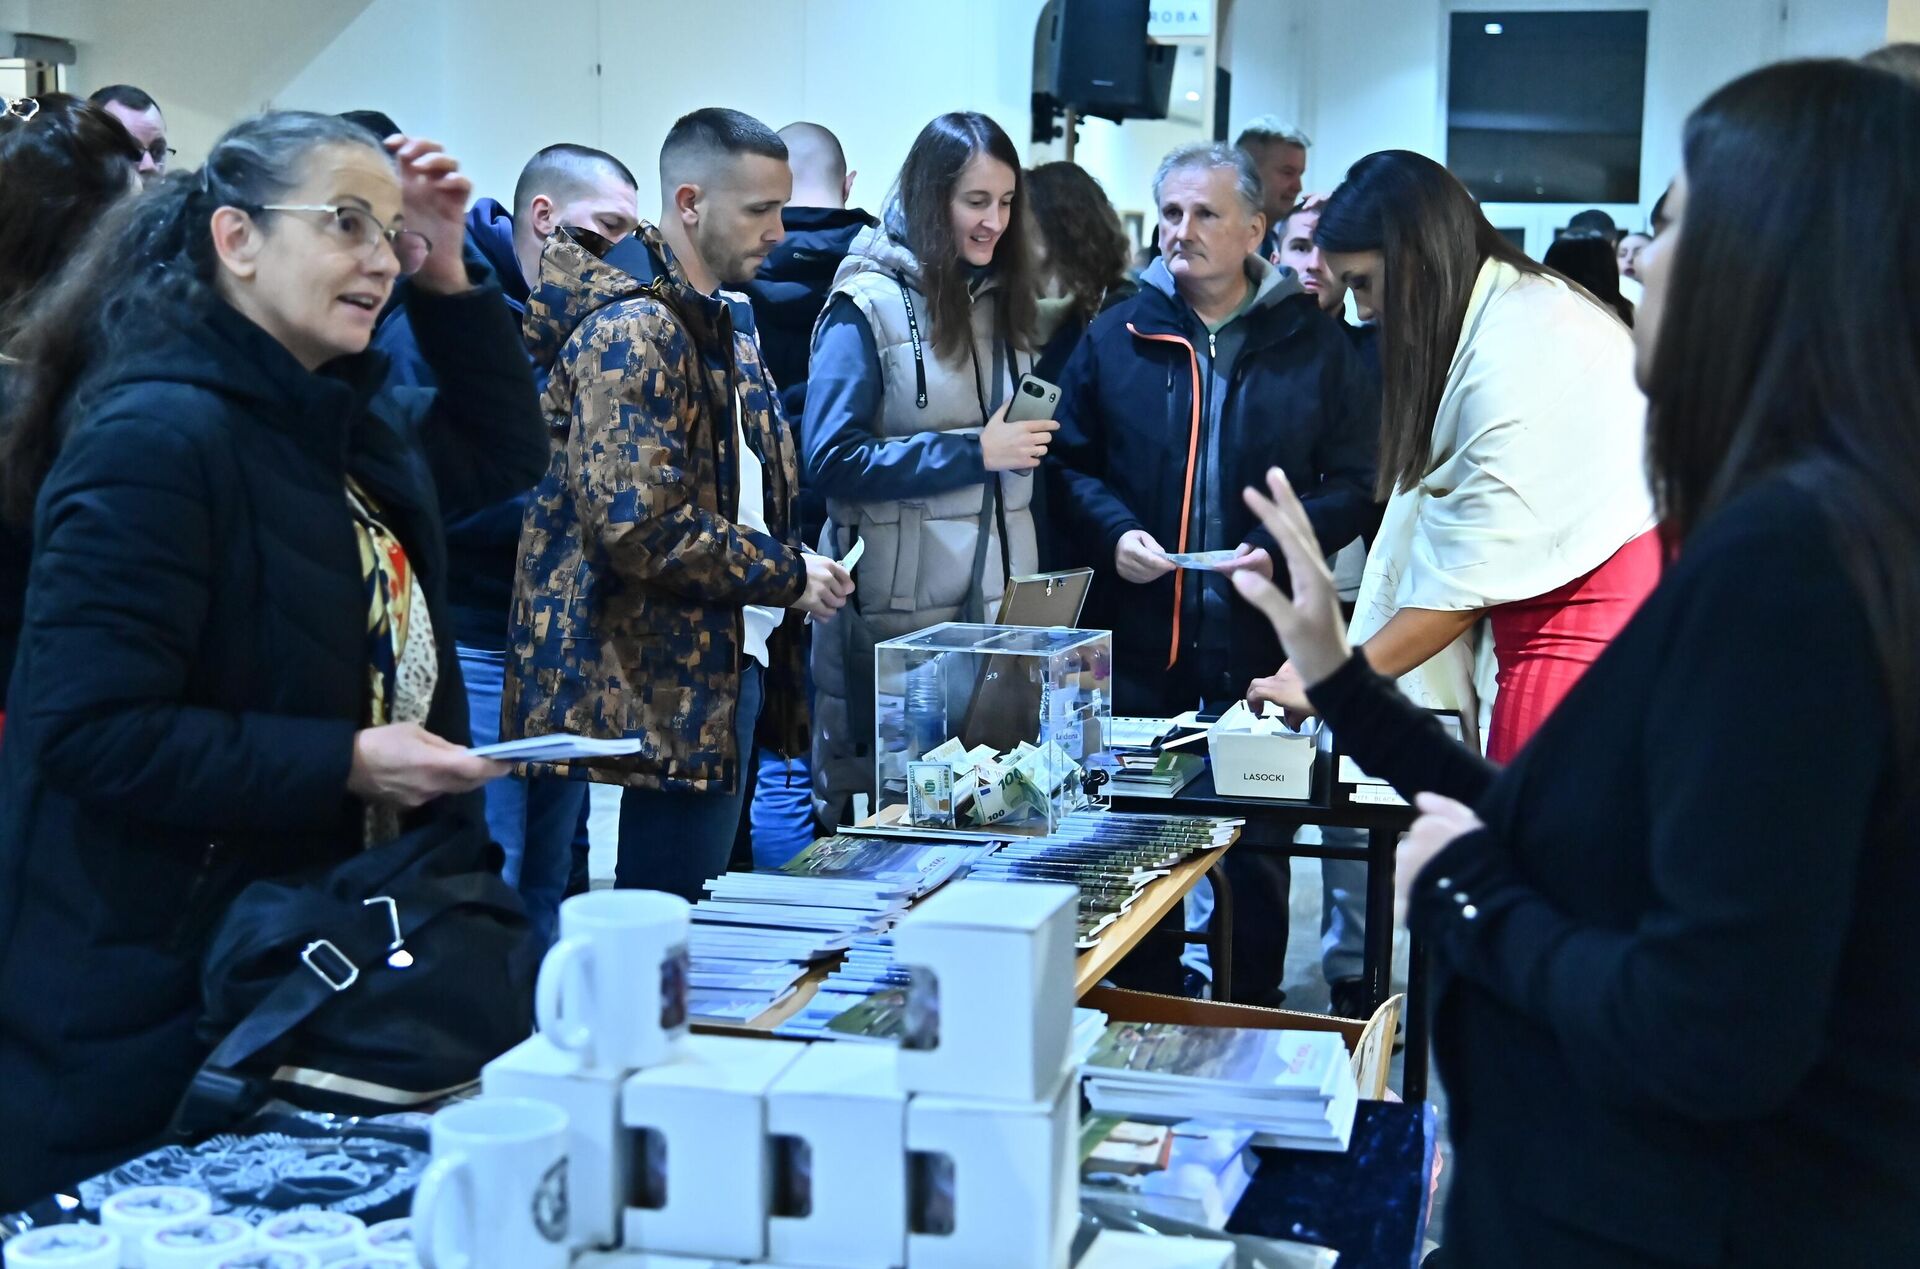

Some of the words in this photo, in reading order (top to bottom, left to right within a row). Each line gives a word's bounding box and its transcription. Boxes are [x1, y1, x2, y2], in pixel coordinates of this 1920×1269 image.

[912, 329, 921, 360] FASHION
[998, 768, 1023, 790] 100
[1243, 773, 1285, 781] LASOCKI
[987, 809, 1005, 822] 100
